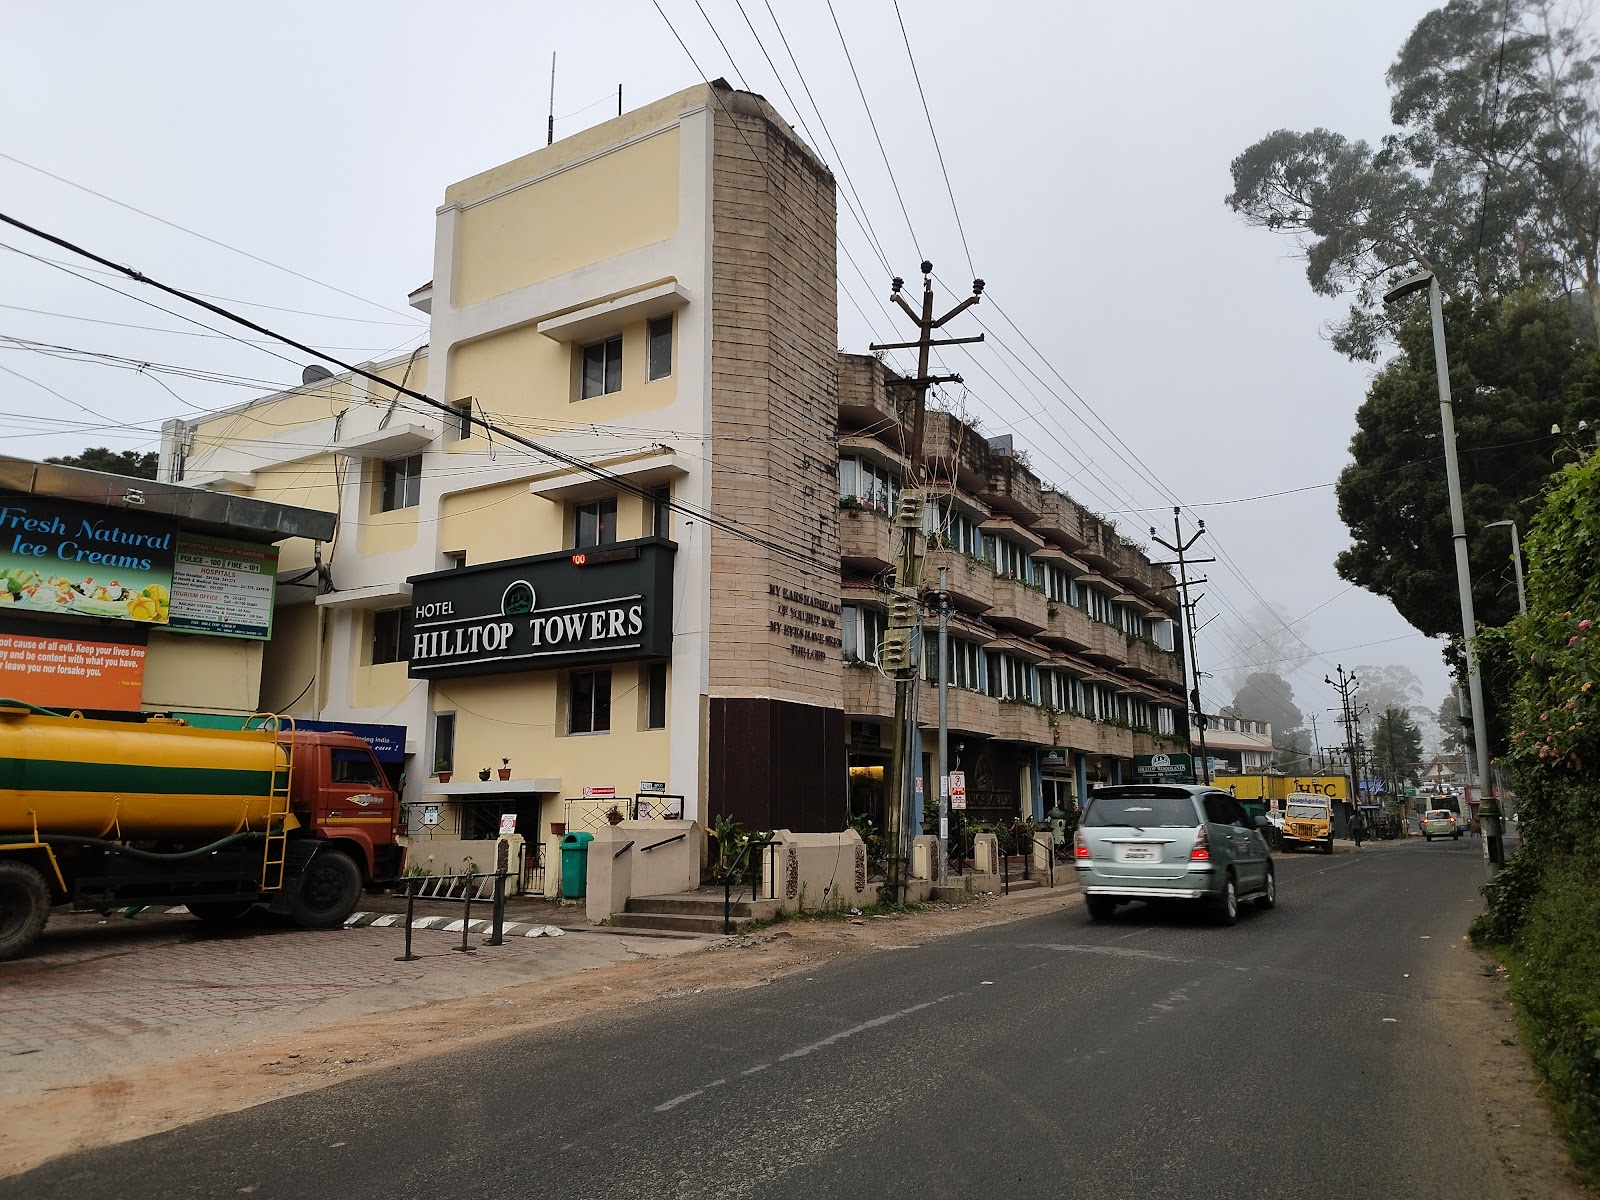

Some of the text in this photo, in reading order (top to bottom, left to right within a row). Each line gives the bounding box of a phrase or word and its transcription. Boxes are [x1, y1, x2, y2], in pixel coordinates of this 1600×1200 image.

[0, 506, 171, 550] Fresh Natural
[11, 534, 152, 571] Ice Creams
[236, 550, 265, 558] NUMBERS
[180, 554, 204, 564] POLICE
[210, 559, 221, 567] 100
[227, 561, 243, 569] FIRE
[249, 564, 259, 572] 101
[201, 568, 236, 578] HOSPITALS
[173, 590, 219, 601] TOURISM OFFICE
[768, 583, 781, 596] MY
[415, 601, 454, 619] HOTEL
[411, 605, 643, 660] HILLTOP TOWERS
[769, 621, 781, 634] MY
[13, 639, 37, 650] cause
[38, 640, 47, 650] of
[48, 641, 58, 651] all
[58, 642, 74, 652] evil.
[76, 643, 95, 656] Keep
[95, 647, 112, 656] your
[113, 646, 130, 657] lives
[130, 647, 145, 658] free
[9, 650, 25, 660] and
[26, 650, 36, 660] be
[37, 653, 66, 664] content
[68, 654, 84, 665] with
[86, 655, 104, 666] what
[104, 658, 118, 668] you
[119, 657, 138, 668] have.
[5, 661, 26, 672] leave
[27, 664, 41, 674] you
[43, 664, 55, 674] nor
[57, 665, 85, 676] forsake
[86, 668, 101, 678] you.
[375, 736, 390, 744] India
